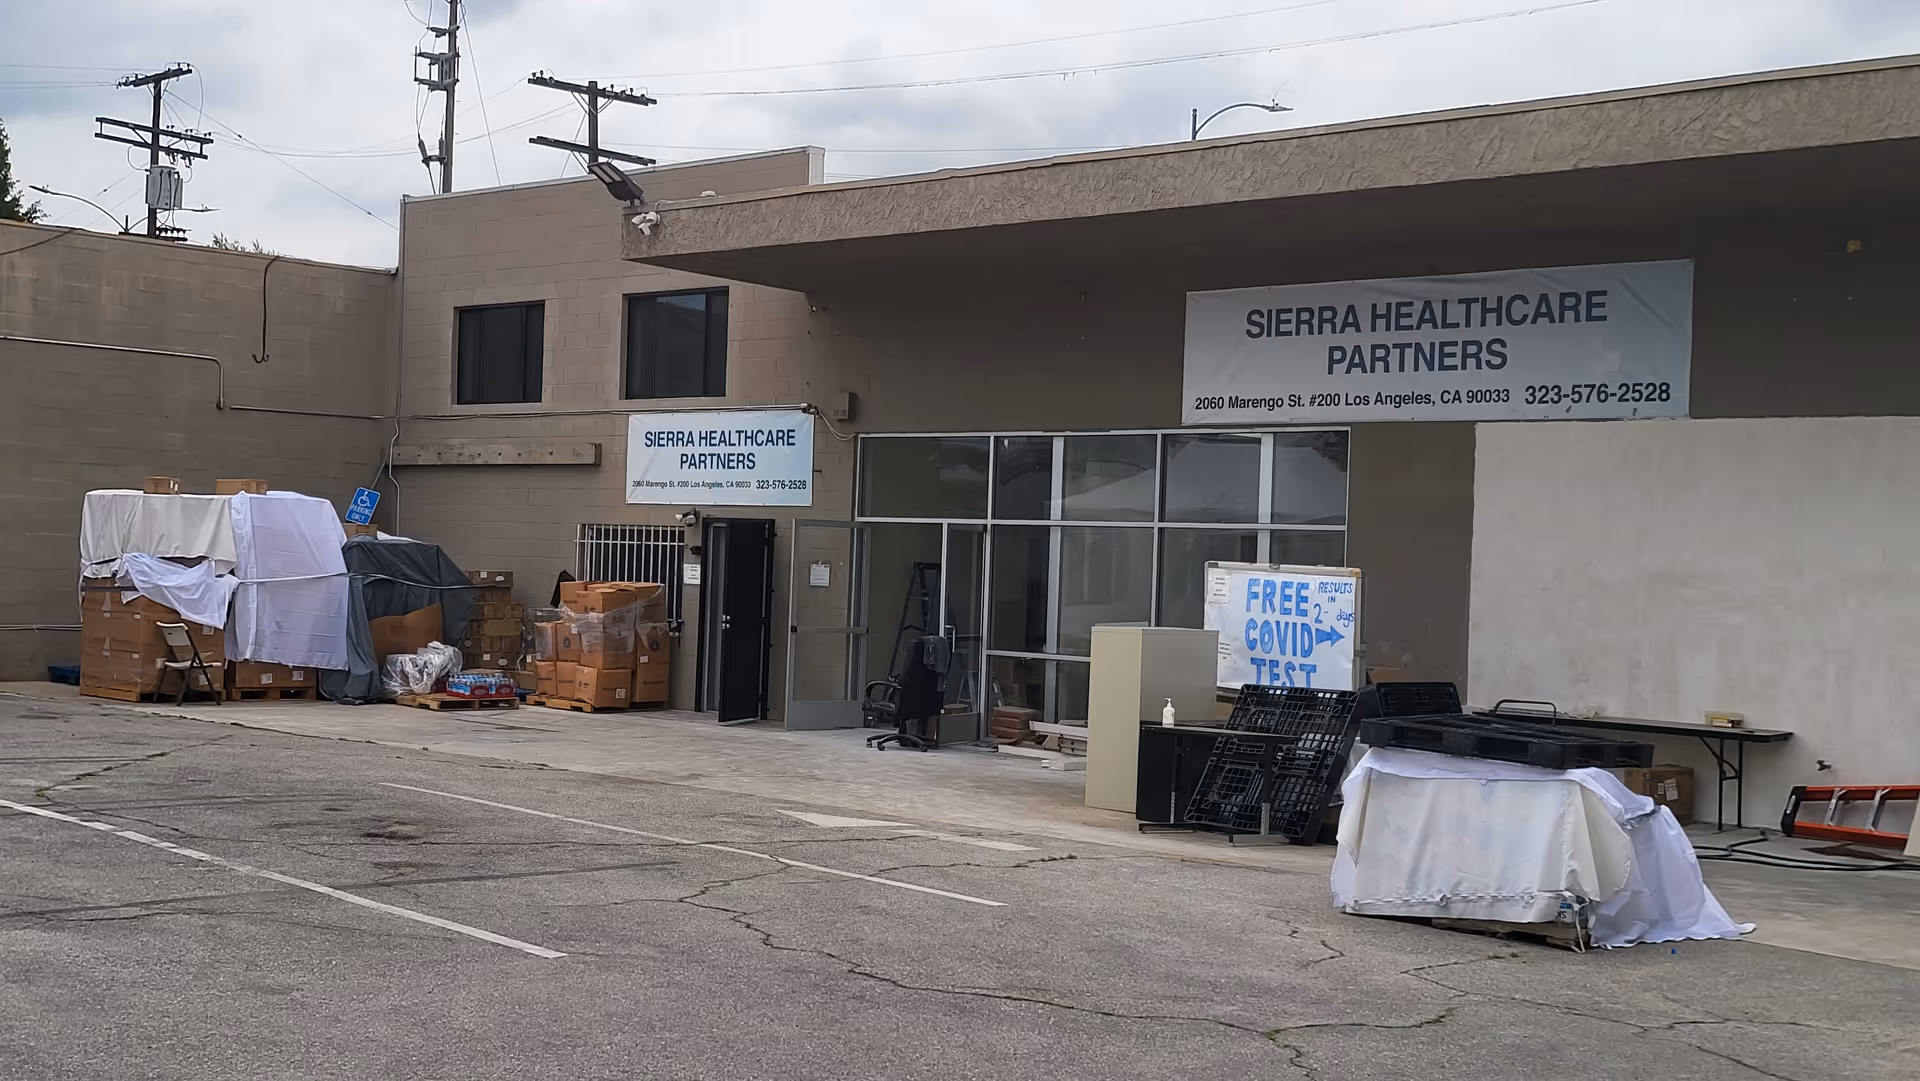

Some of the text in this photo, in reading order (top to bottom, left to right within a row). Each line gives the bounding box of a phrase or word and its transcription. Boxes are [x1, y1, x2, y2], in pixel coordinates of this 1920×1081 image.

[1246, 290, 1607, 338] SIERRA HEALTHCARE
[1327, 338, 1508, 375] PARTNERS
[1195, 381, 1671, 411] 2060 Marengo St. #200 Los Angeles, CA 90033 323-576-2528
[644, 429, 796, 448] SIERRA HEALTHCARE
[680, 452, 756, 470] PARTNERS
[645, 480, 667, 489] Marengo
[677, 480, 689, 488] #200
[690, 480, 700, 488] Los
[701, 480, 724, 490] Angeles,
[725, 480, 734, 488] CA
[735, 480, 751, 488] 90033
[756, 479, 807, 490] 323-576-2528
[1245, 578, 1310, 617] FREE
[1318, 581, 1353, 594] RESULTS
[1336, 608, 1356, 628] days
[1244, 617, 1314, 658] COVID
[1250, 657, 1317, 689] TEST
